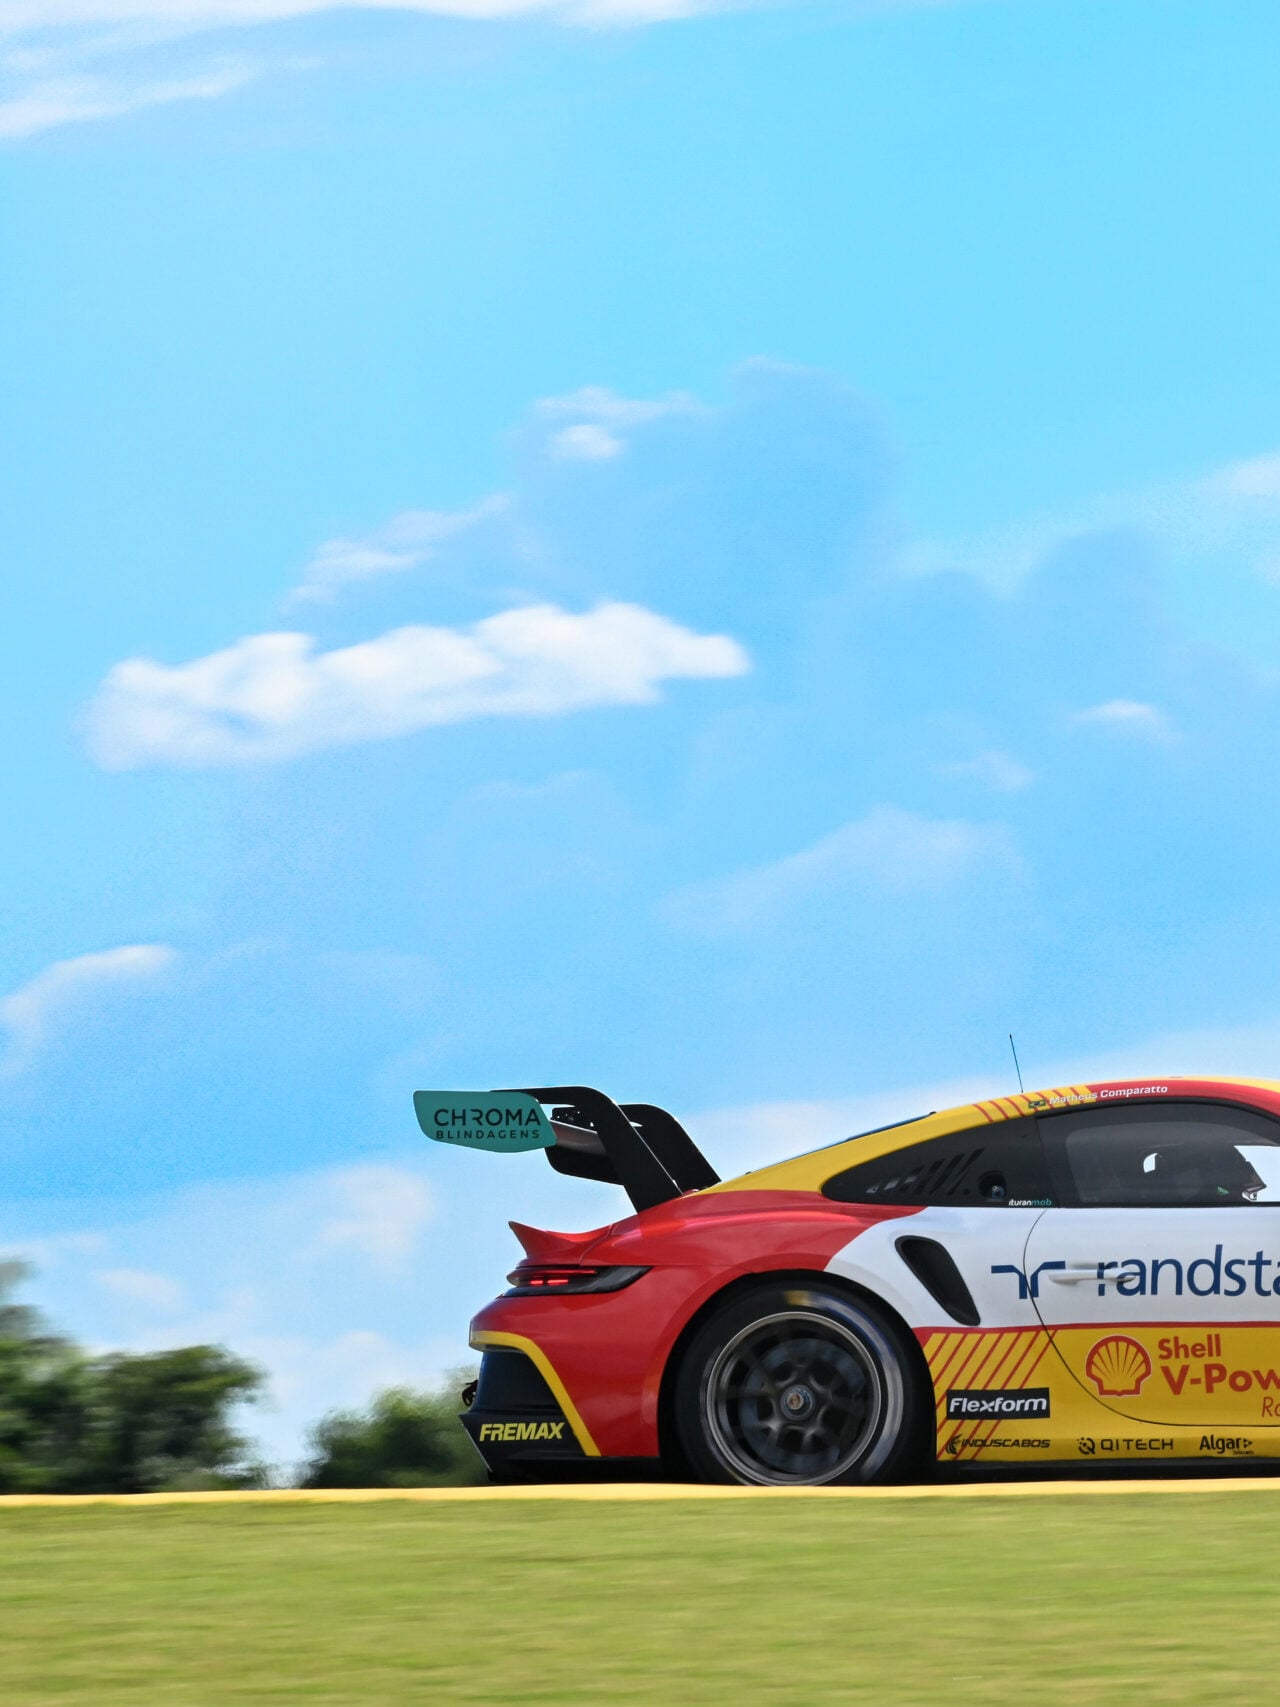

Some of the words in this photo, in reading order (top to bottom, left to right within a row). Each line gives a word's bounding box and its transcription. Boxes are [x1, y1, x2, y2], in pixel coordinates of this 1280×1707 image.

[1100, 1086, 1169, 1099] Comparatto
[433, 1108, 541, 1127] CHROMA
[436, 1130, 540, 1139] BLINDAGENS
[1157, 1333, 1222, 1360] Shell
[949, 1397, 1048, 1413] Flexform
[479, 1422, 565, 1442] FREMAX
[960, 1438, 1051, 1448] INDUSCABOS
[1199, 1434, 1242, 1454] Algar
